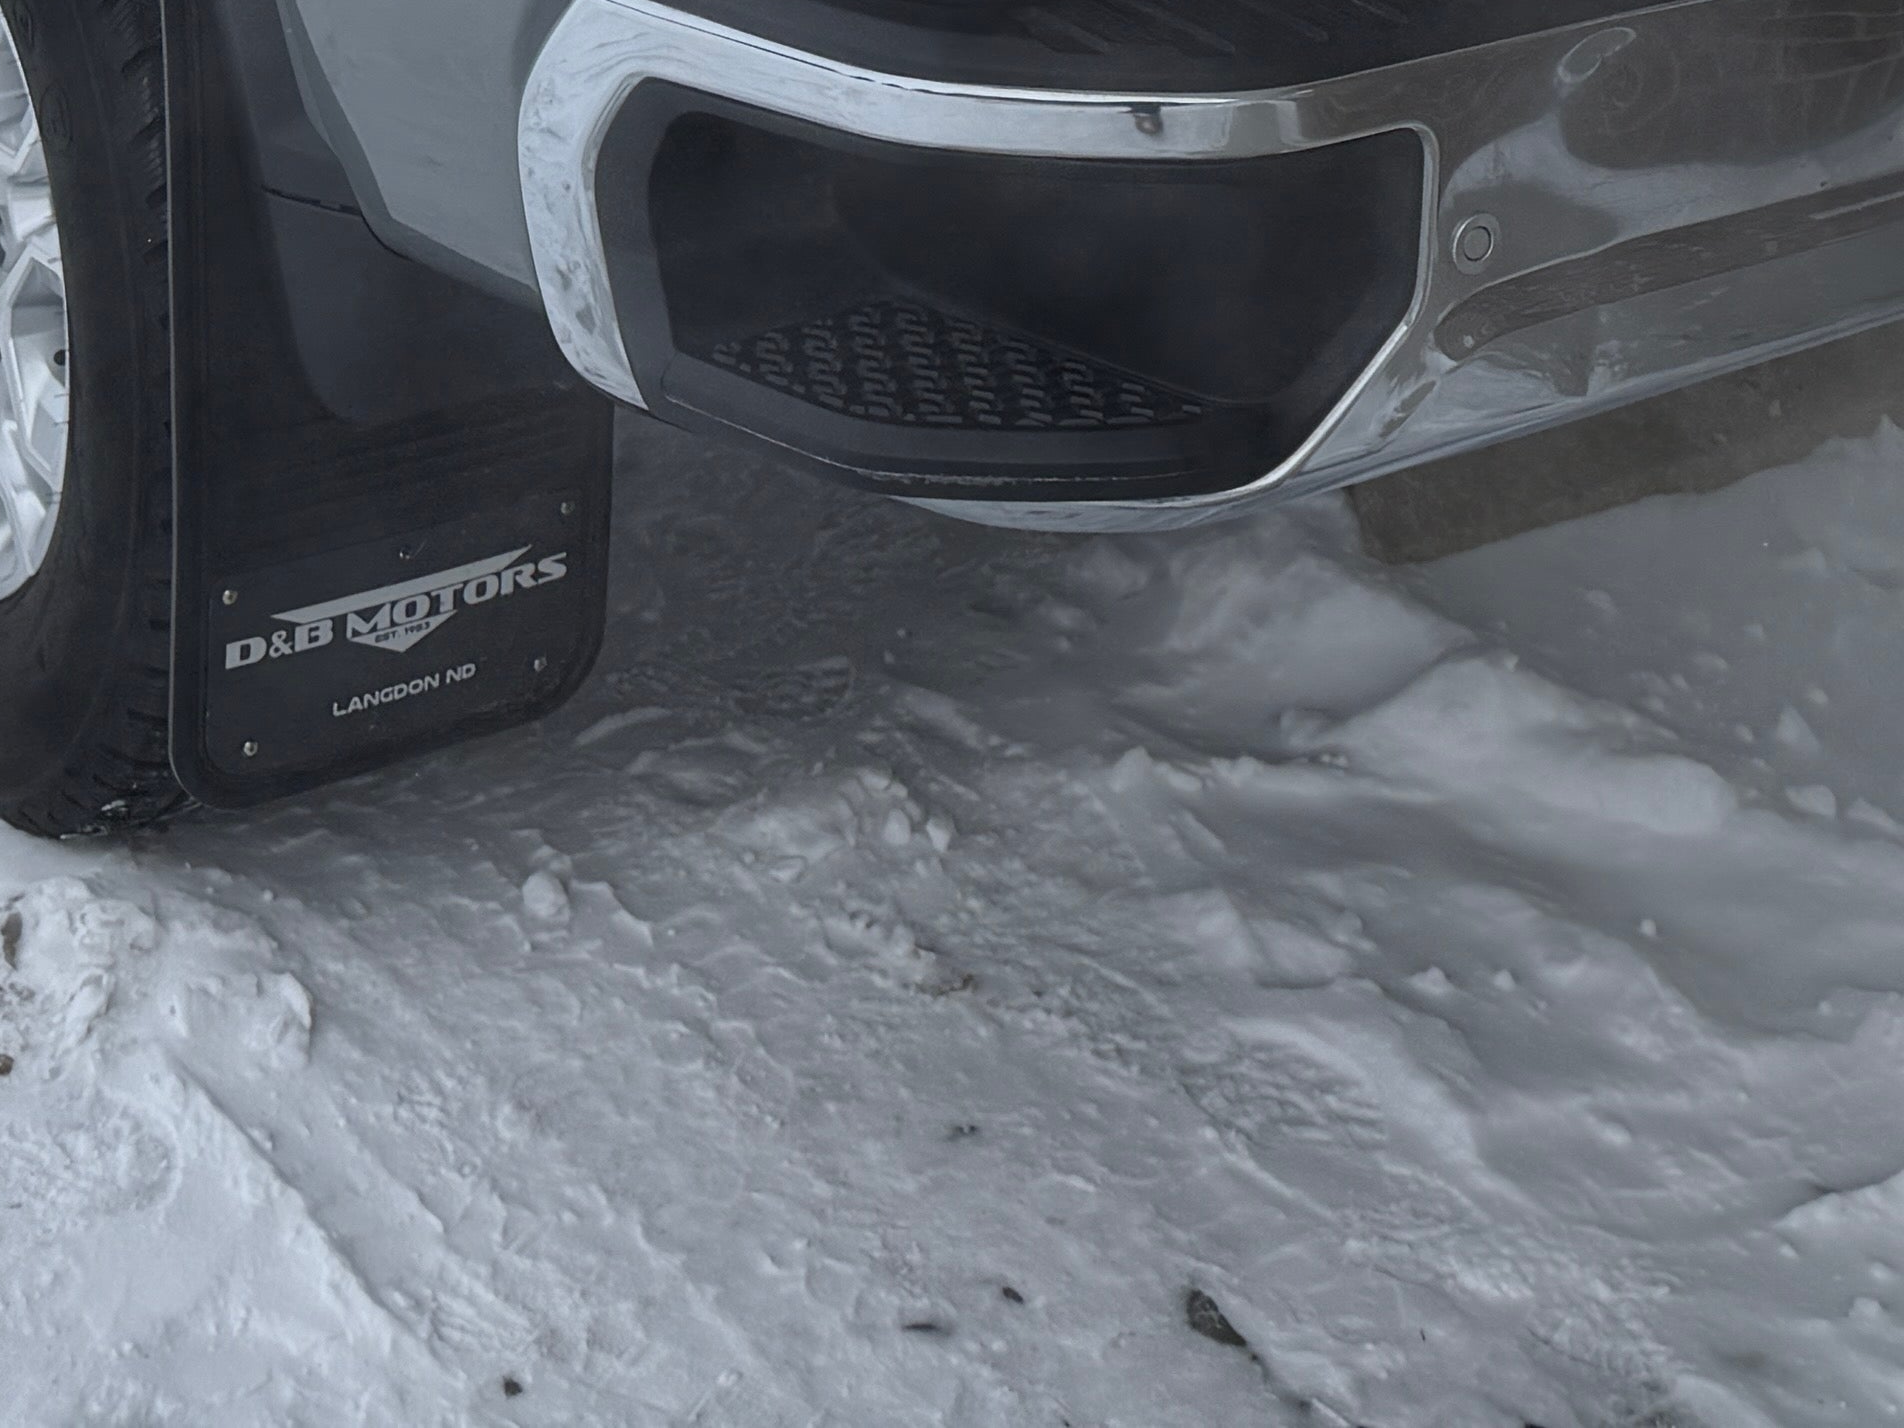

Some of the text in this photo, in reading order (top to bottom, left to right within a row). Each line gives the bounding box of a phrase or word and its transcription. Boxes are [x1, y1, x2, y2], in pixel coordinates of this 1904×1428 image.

[225, 552, 568, 670] D&B MOTORS
[332, 663, 477, 717] LANGDON ND
